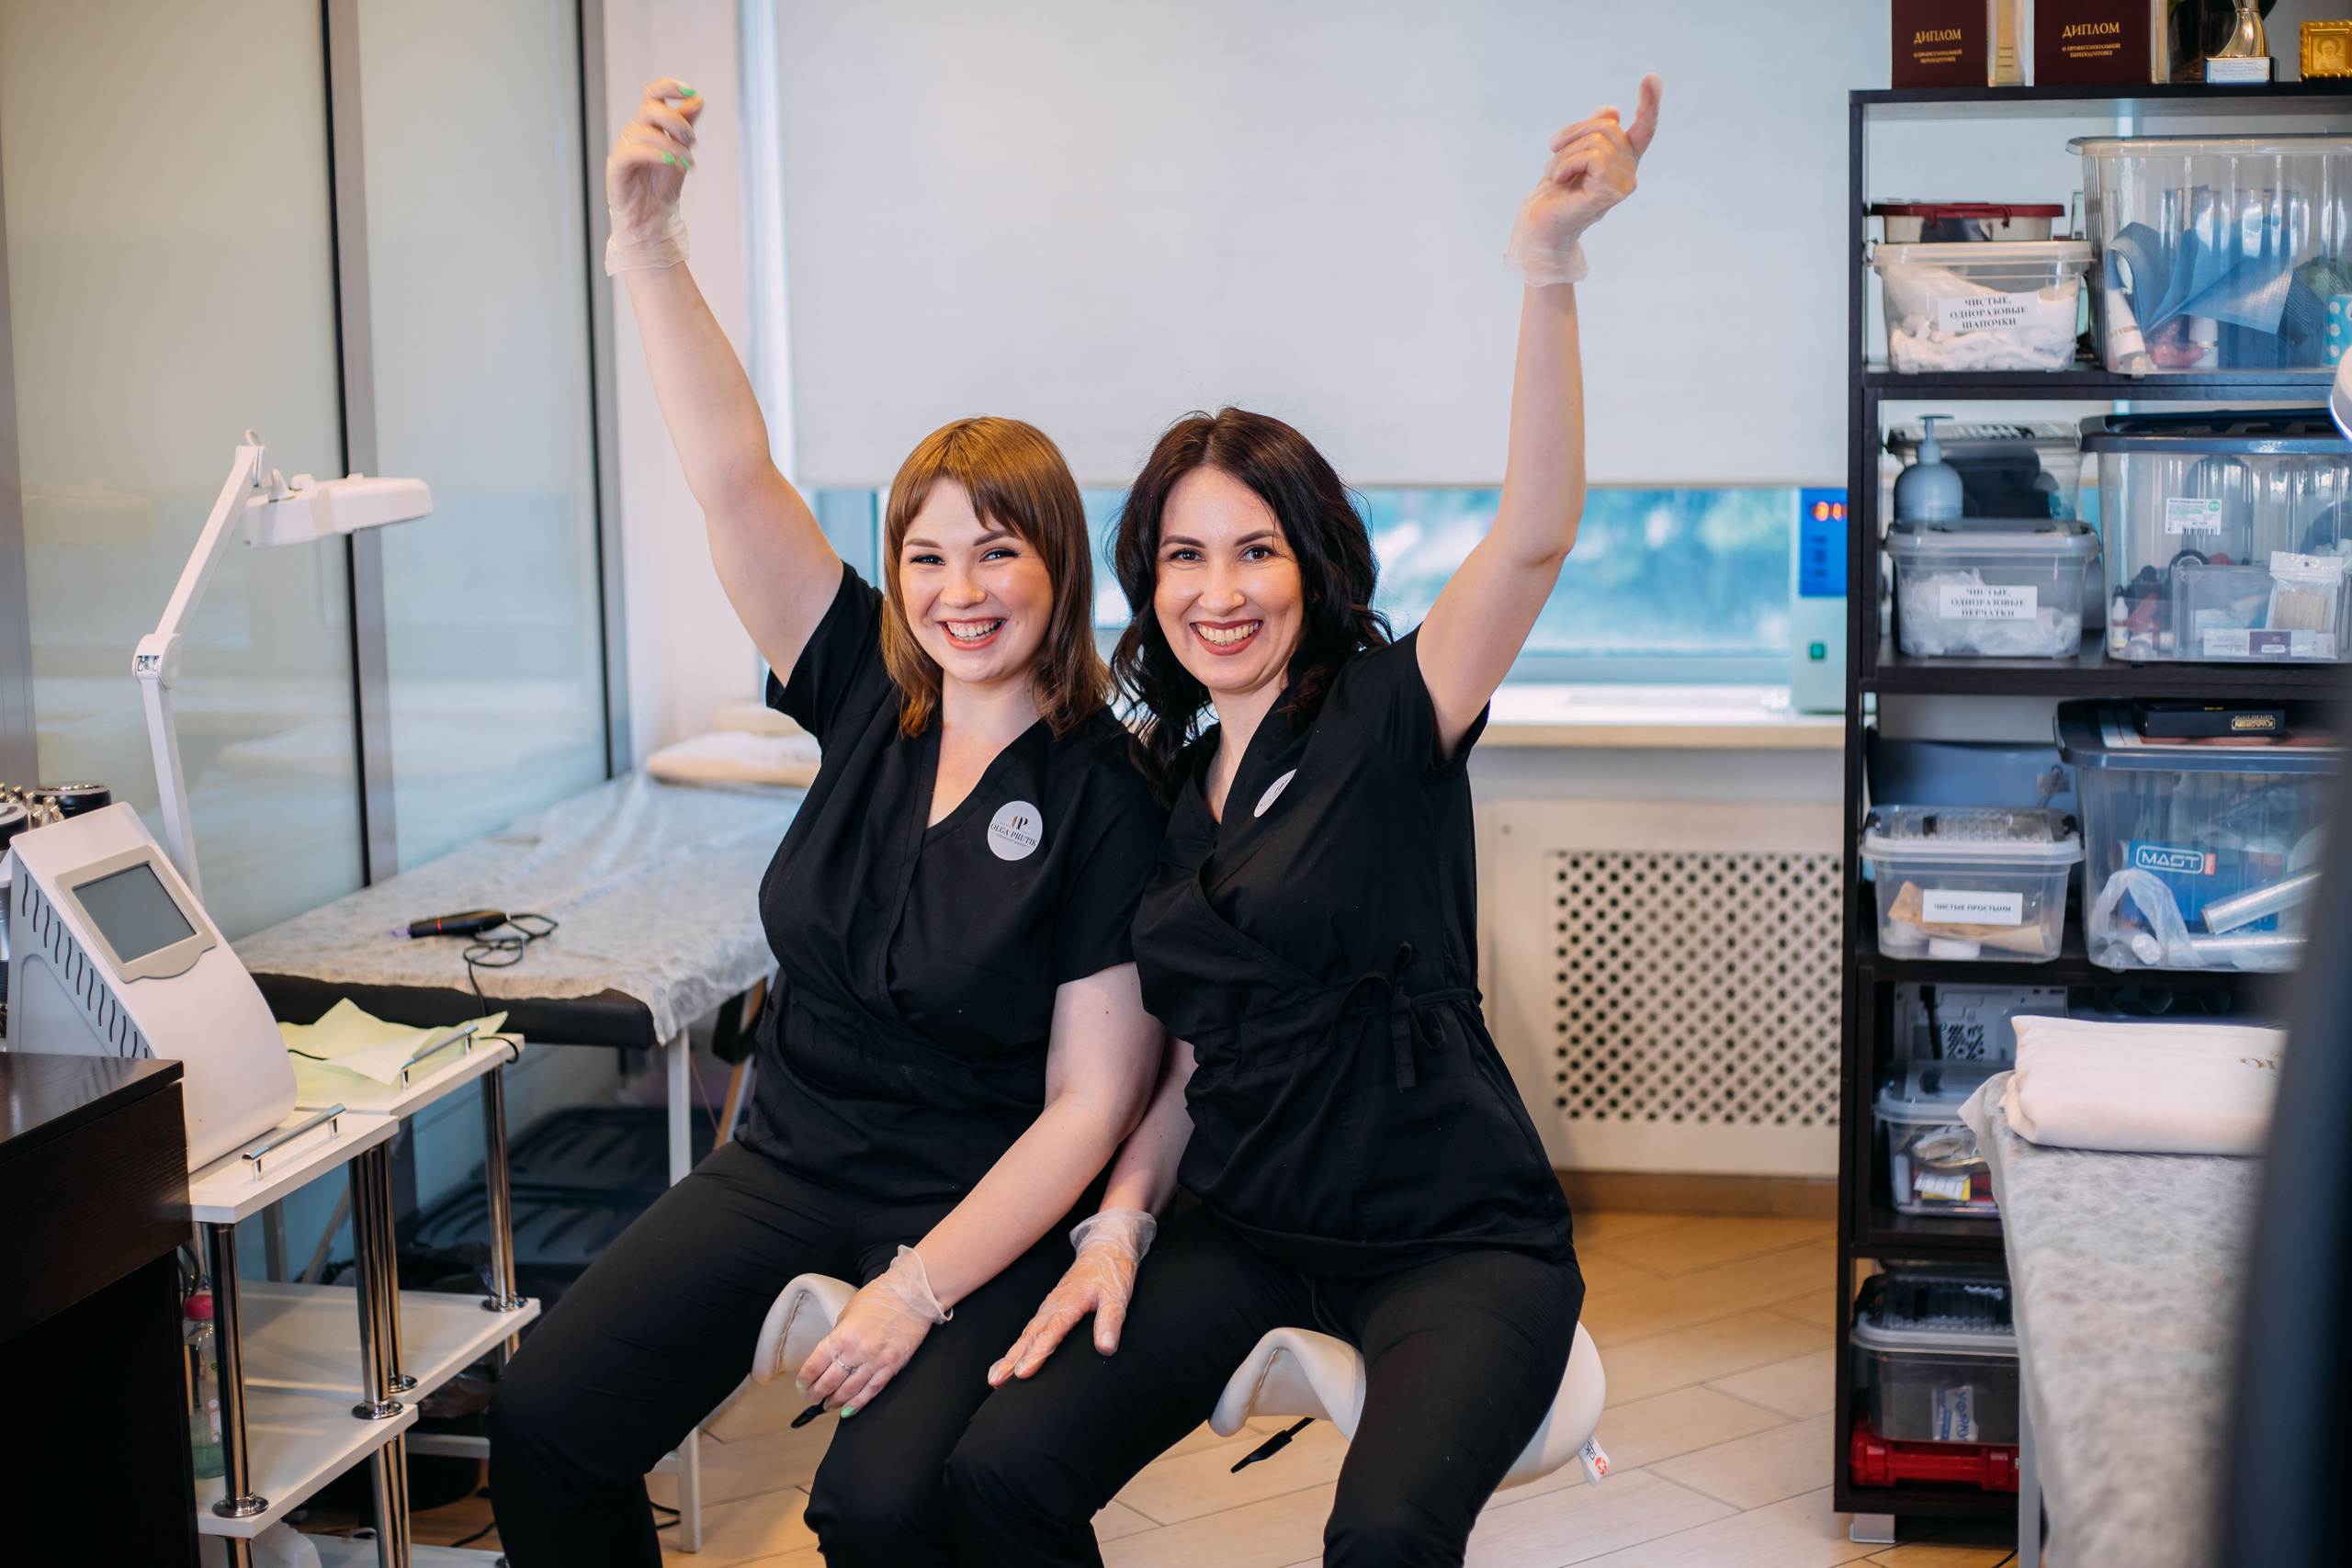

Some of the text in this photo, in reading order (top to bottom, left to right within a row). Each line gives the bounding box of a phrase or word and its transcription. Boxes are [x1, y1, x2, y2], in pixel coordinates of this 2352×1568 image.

[1913, 28, 1962, 45] ДИПЛОМ
[2062, 22, 2120, 39] ДИПЛОМ
[1950, 306, 2027, 319] ОДНОРАЗОВЫЕ
[1962, 317, 2016, 329] ШАПОЧКИ
[1951, 598, 2024, 607] ОДНОРАЗОВЫЕ
[1962, 608, 2015, 617] ПЕРЧАТКИ
[990, 823, 1010, 837] OLGA
[1011, 830, 1038, 847] PRUTIK
[2142, 851, 2199, 869] MAST
[1934, 902, 2012, 914] ЧИСТЫЕ ПРОСТЫНИ
